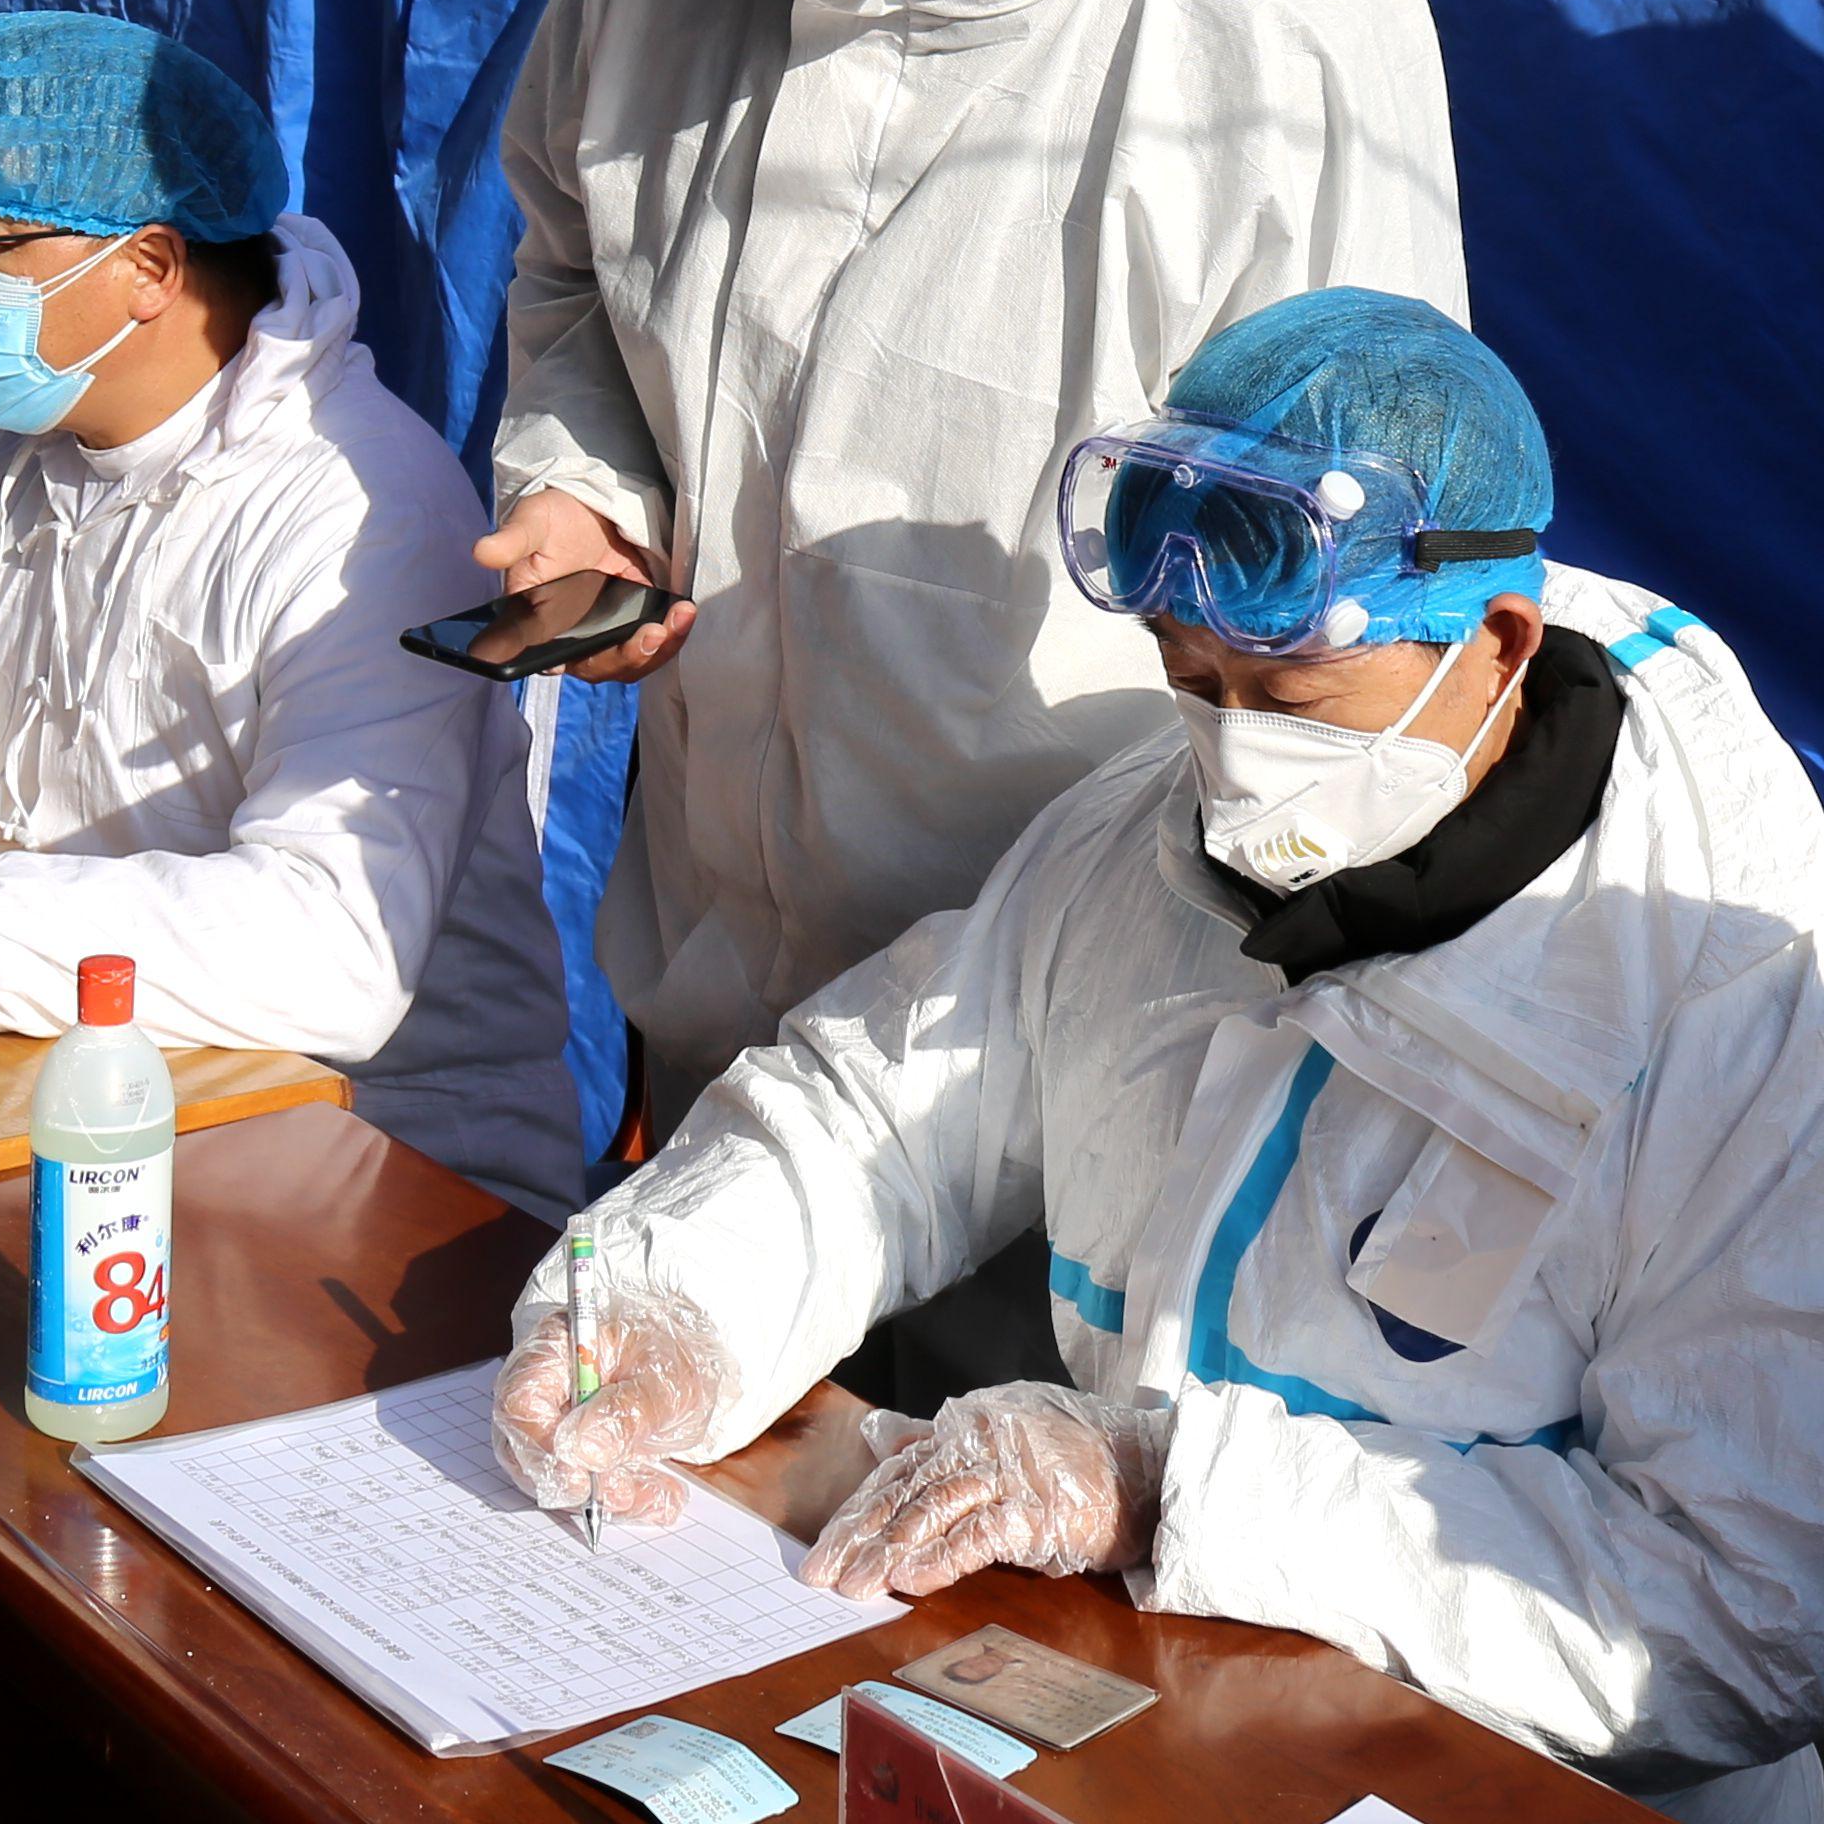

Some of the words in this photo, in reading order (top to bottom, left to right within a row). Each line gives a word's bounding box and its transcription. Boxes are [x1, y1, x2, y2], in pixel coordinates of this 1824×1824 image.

[1101, 456, 1117, 469] 3M
[69, 1165, 140, 1186] LIRCON
[75, 1214, 143, 1257] 利尔康
[92, 1251, 165, 1334] 84
[78, 1383, 138, 1402] LIRCON
